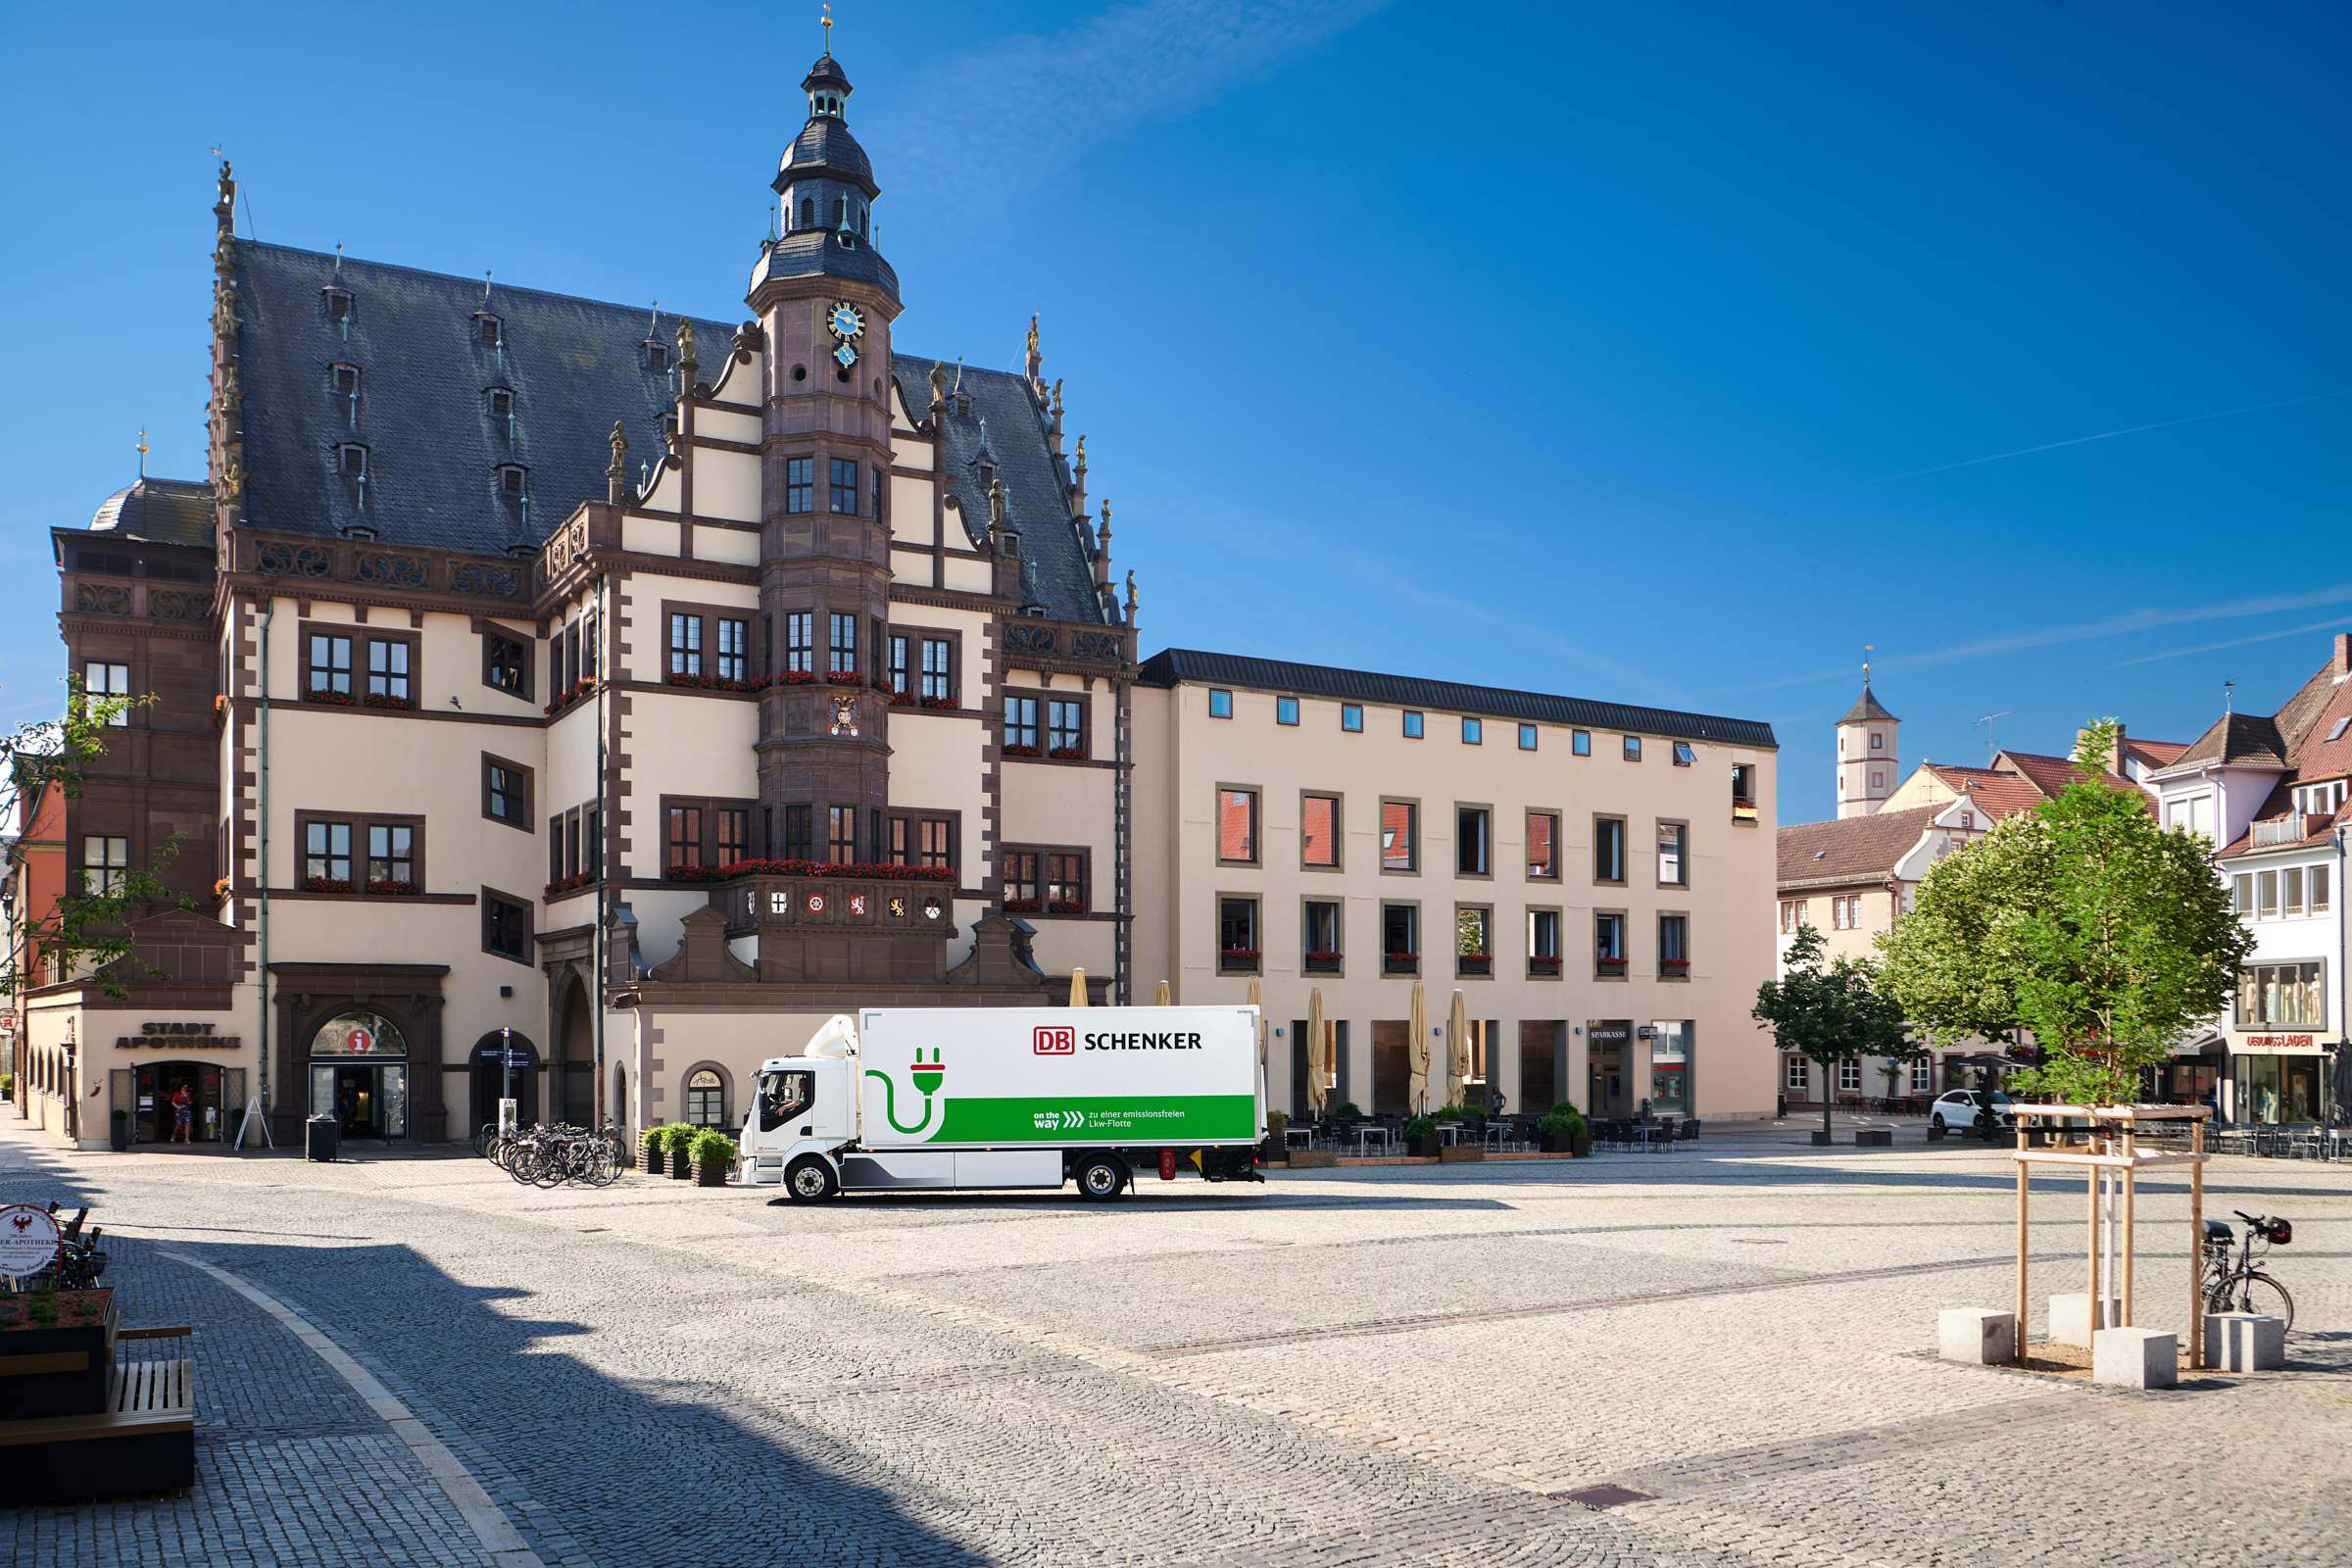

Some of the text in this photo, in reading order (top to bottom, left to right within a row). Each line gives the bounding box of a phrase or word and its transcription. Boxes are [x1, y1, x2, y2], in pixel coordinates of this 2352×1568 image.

[142, 1022, 216, 1036] STADT
[115, 1036, 241, 1049] APOTHEKE
[1038, 1030, 1202, 1052] DB SCHENKER
[1123, 1109, 1185, 1118] emissionsfreien
[1034, 1119, 1059, 1131] way
[1089, 1119, 1132, 1128] Lkw-Flotte
